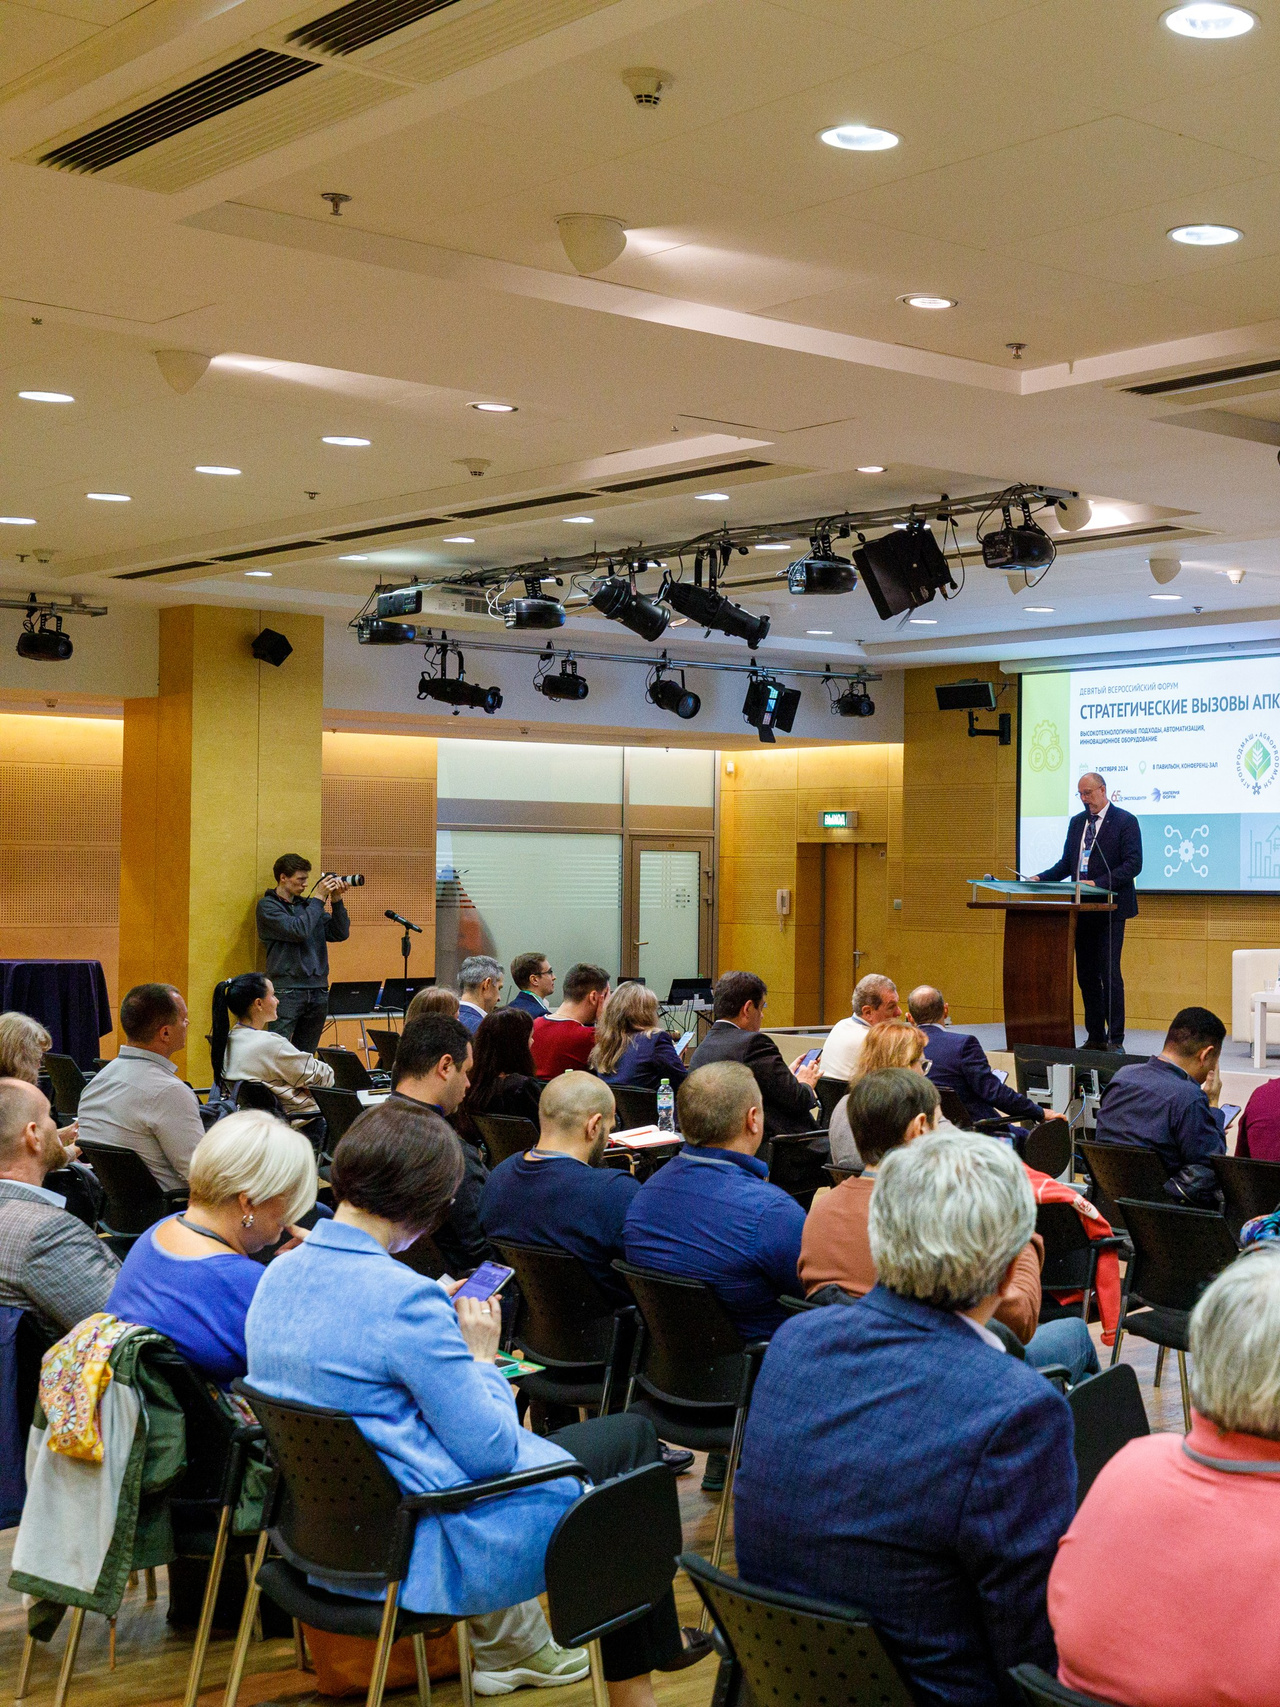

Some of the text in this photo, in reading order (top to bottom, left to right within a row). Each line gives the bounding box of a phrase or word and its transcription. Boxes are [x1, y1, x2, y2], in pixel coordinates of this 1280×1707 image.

[1079, 681, 1179, 696] ДЕВЯТЫЙ ВСЕРОССИЙСКИЙ ФОРУМ
[1080, 693, 1280, 719] СТРАТЕГИЧЕСКИЕ ВЫЗОВЫ АПК
[1079, 735, 1158, 745] ИННОВАЦИОННОЕ ОБОРУДОВАНИЕ
